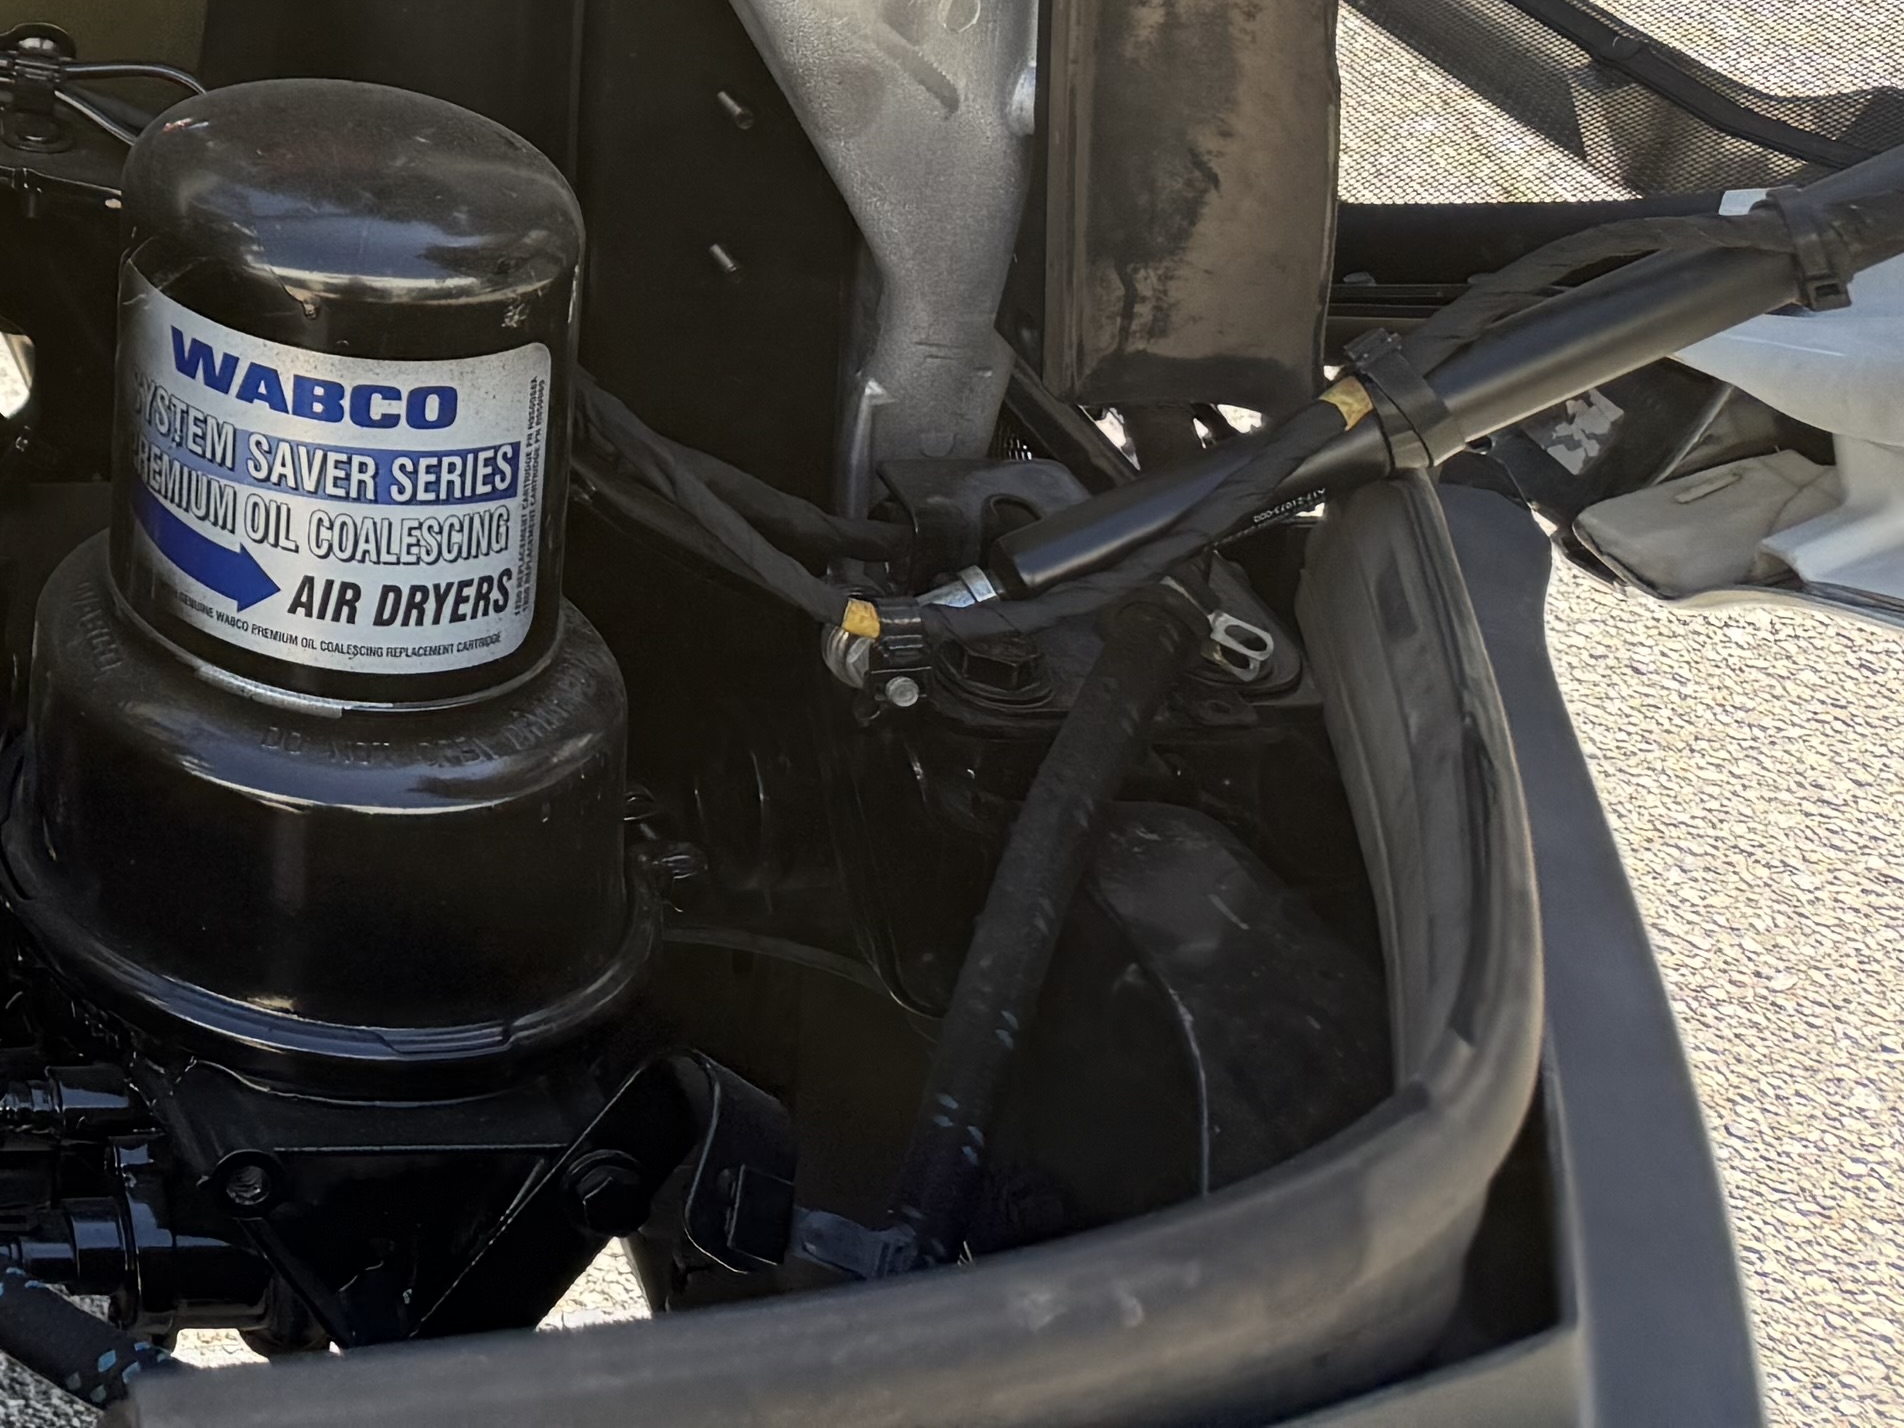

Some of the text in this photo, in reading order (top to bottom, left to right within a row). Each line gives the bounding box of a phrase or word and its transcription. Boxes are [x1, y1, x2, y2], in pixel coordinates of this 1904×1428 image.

[170, 325, 459, 430] WABCO
[246, 431, 377, 503] SAVER
[389, 443, 514, 504] SERIES
[244, 493, 299, 553] OIL
[308, 509, 510, 567] COALESCING
[287, 567, 514, 627] AIR DRYERS
[215, 611, 249, 632] WABCO
[251, 623, 298, 646] PREMIUM
[300, 636, 317, 650] OIL
[320, 640, 384, 658] COALESCING
[385, 643, 454, 658] REPLACEMENT
[456, 631, 502, 653] CARTRIDGE
